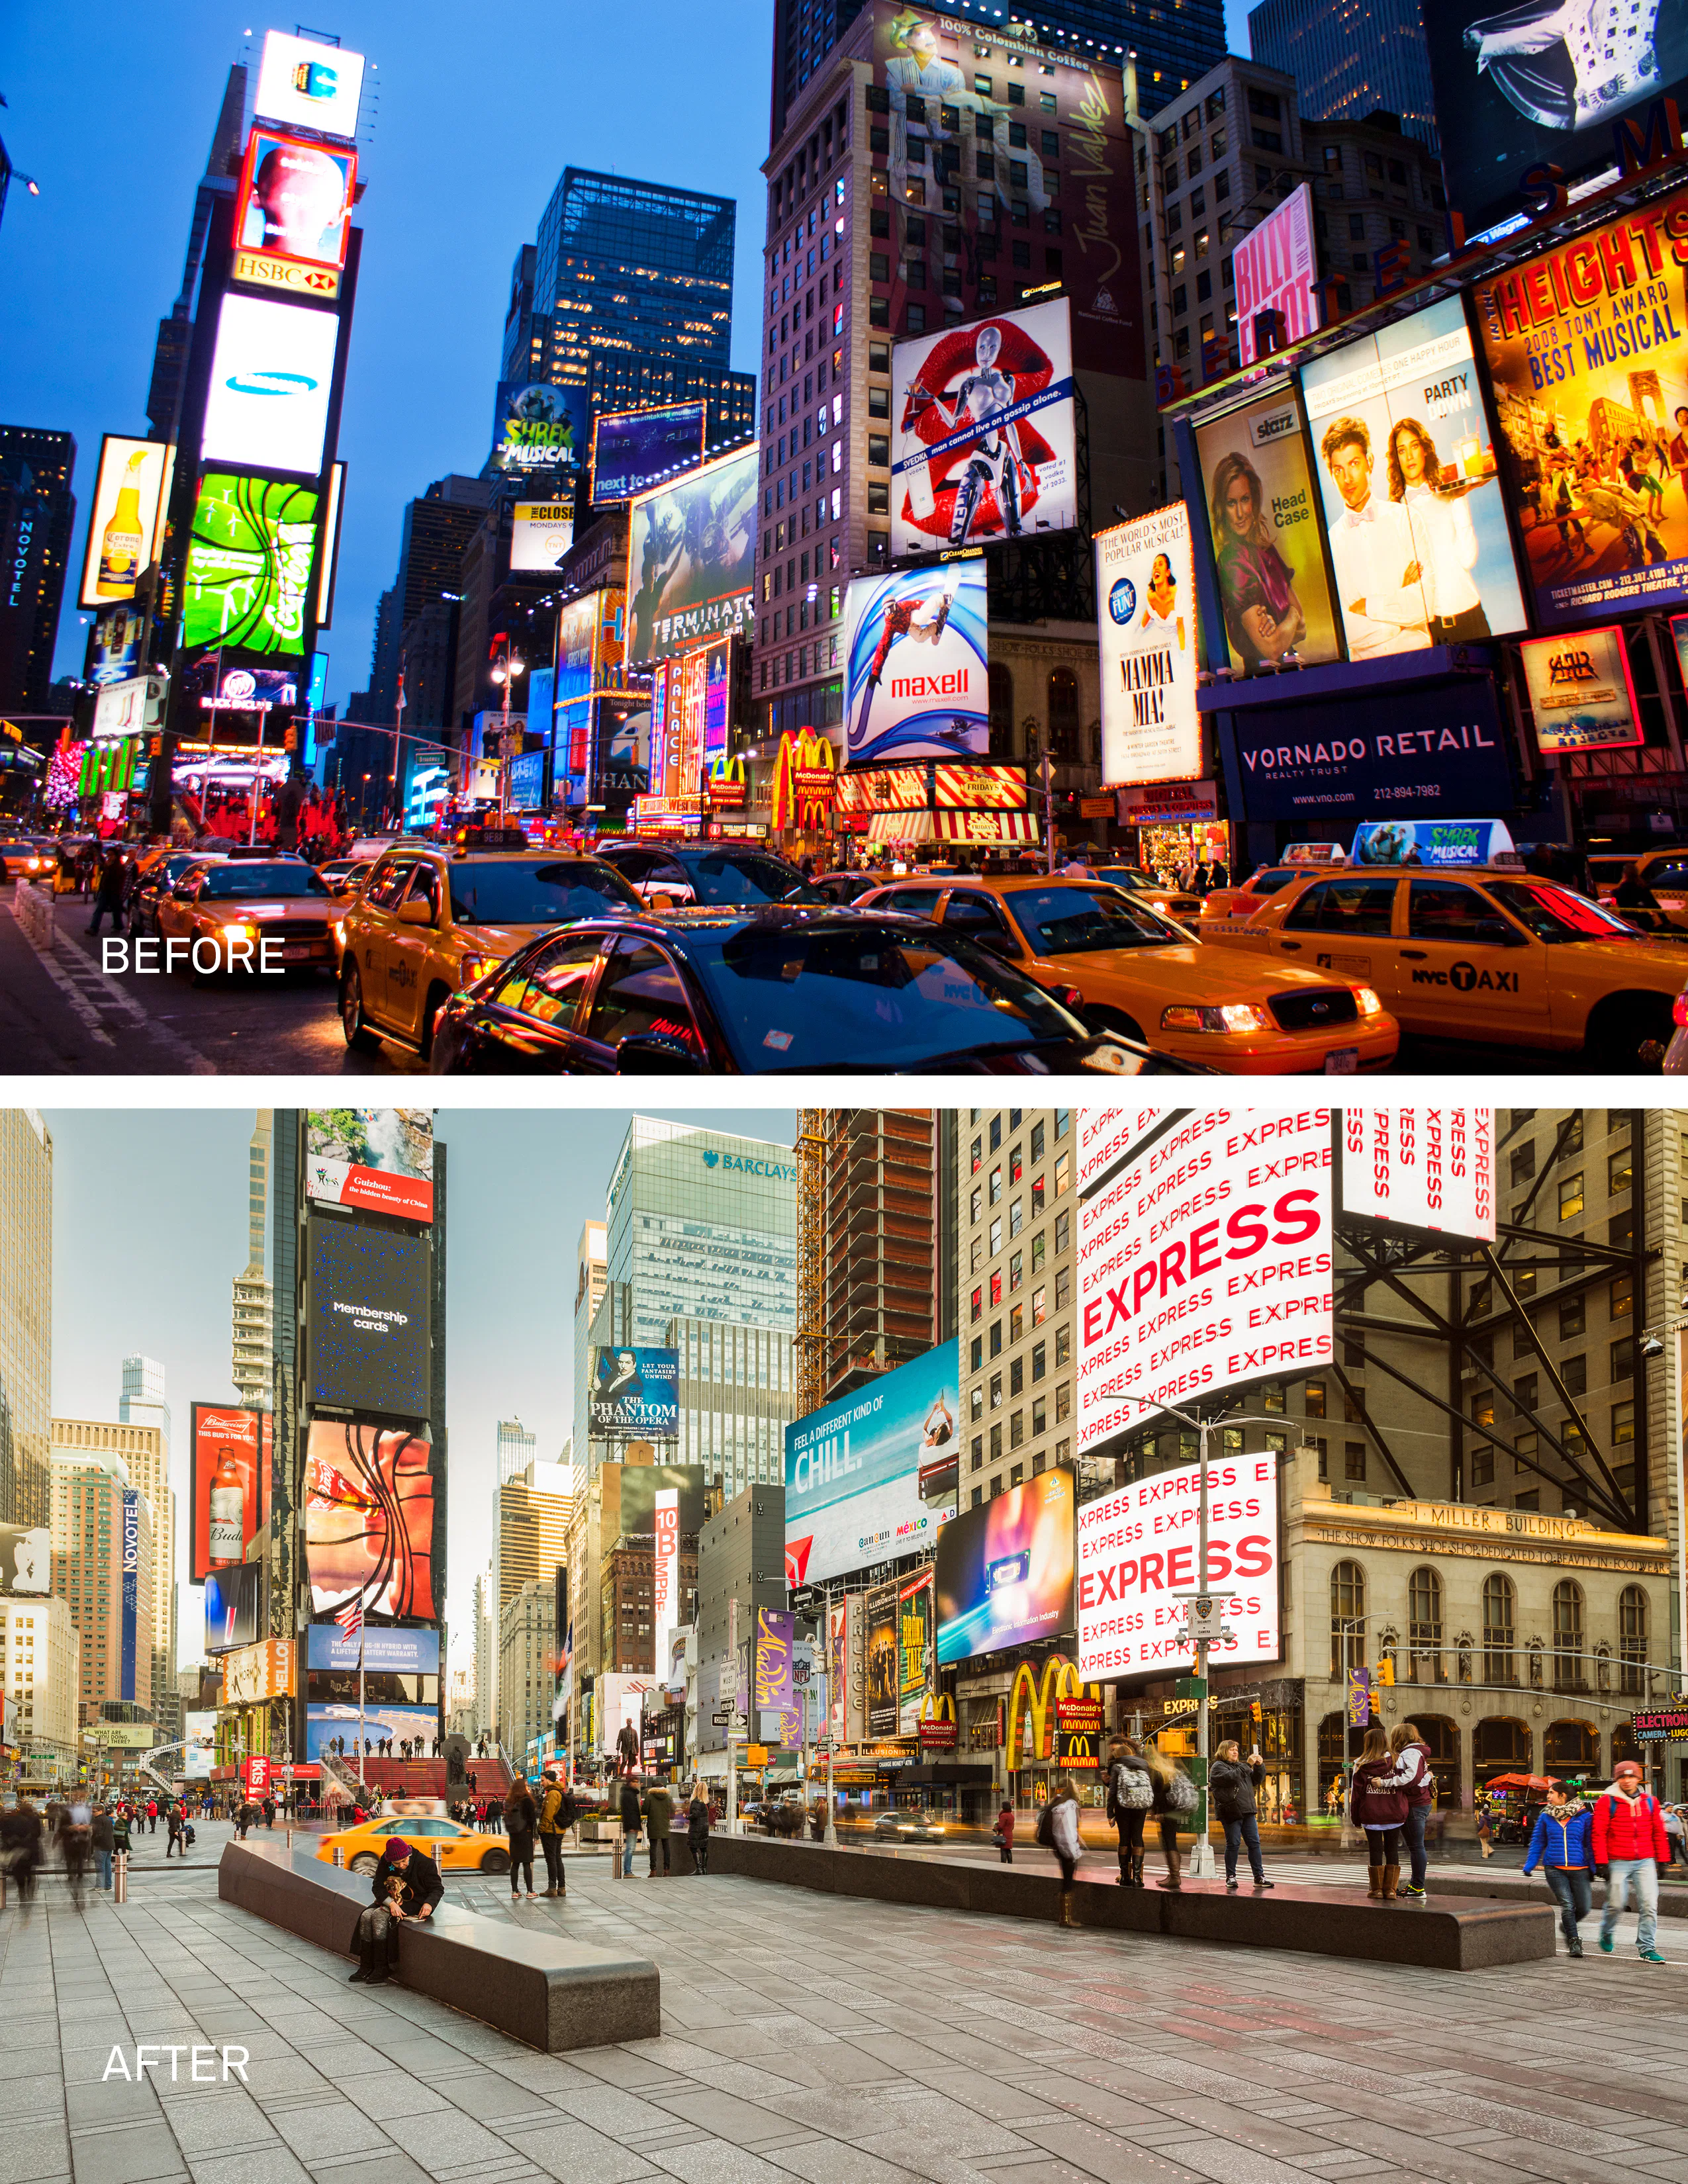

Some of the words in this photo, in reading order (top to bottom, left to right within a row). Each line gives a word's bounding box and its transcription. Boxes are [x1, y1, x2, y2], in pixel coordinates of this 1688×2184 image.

[940, 18, 971, 36] 100%
[975, 28, 1044, 58] Colombian
[238, 258, 301, 284] HSBC
[1235, 205, 1293, 320] BILLY
[1496, 203, 1688, 341] HEIGHTS
[1524, 326, 1558, 355] 2008
[1565, 308, 1601, 338] TONY
[1614, 281, 1669, 320] AWARD
[1438, 337, 1460, 353] HOUR
[1529, 342, 1575, 391] BEST
[1583, 304, 1681, 371] MUSICAL
[1424, 373, 1469, 404] PARTY
[630, 412, 665, 423] breathtaking
[1428, 390, 1472, 421] DOWN
[503, 419, 575, 447] SHREK
[931, 443, 947, 454] man
[949, 429, 974, 447] cannot
[976, 422, 990, 435] live
[992, 416, 1002, 427] on
[1004, 404, 1031, 422] gossip
[1033, 390, 1062, 406] alone.
[1258, 410, 1294, 438] starz
[504, 444, 575, 462] MUSICAL
[903, 453, 928, 469] SVEDKA
[909, 465, 926, 476] VODKA
[1038, 465, 1057, 473] voted
[1044, 469, 1064, 480] vodka
[596, 475, 626, 490] next
[1272, 490, 1306, 513] Head
[1121, 522, 1157, 544] WORLD'S
[1160, 510, 1184, 529] MOST
[1274, 508, 1309, 529] Case
[107, 532, 140, 543] Corona
[9, 522, 33, 606] NOVOTEL
[1105, 541, 1141, 563] POPULAR
[1551, 579, 1613, 600] TICKETMASTER.COM
[1571, 594, 1602, 606] RICHARD
[1604, 586, 1640, 600] RODGERS
[891, 668, 968, 698] maxell
[1120, 649, 1174, 692] MAMMA
[610, 699, 633, 707] Tonight
[912, 695, 968, 704] www.maxell.com
[1133, 688, 1165, 727] MIA!
[669, 667, 681, 766] PALACE
[1243, 738, 1366, 772] VORNADO
[1376, 725, 1495, 756] RETAIL
[1266, 769, 1305, 780] REALTY
[1311, 766, 1348, 776] TRUST
[1293, 791, 1355, 805] www.vno.com
[1374, 784, 1440, 799] 212-894-7982
[1430, 827, 1480, 846] SHREK
[1430, 845, 1479, 859] MUSICAL
[1413, 969, 1448, 985] NYC
[723, 1154, 796, 1182] BARCLAYS
[353, 1177, 391, 1192] Guizhou:
[1138, 1151, 1213, 1218] EXPRESS
[359, 1188, 381, 1199] hidden
[382, 1193, 402, 1204] beauty
[410, 1199, 428, 1209] China
[1083, 1169, 1142, 1230] EXPRESS
[1150, 1179, 1232, 1244] EXPRESS
[1084, 1189, 1321, 1348] EXPRESS
[334, 1302, 408, 1325] Membership
[353, 1319, 389, 1333] cards
[1139, 1288, 1213, 1343] EXPRESS
[1151, 1318, 1233, 1371] EXPRESS
[590, 1402, 677, 1418] PHANTOM
[794, 1432, 808, 1451] FEEL
[816, 1411, 852, 1441] DIFFERENT
[854, 1400, 872, 1422] KIND
[873, 1394, 884, 1414] OF
[206, 1417, 248, 1430] Budweiser
[795, 1430, 863, 1494] CHILL.
[657, 1510, 676, 1529] 10
[1431, 1508, 1491, 1528] MILLER
[1506, 1516, 1575, 1537] BUILDING
[123, 1498, 138, 1572] NOVOTEL
[1082, 1523, 1143, 1559] EXPRESS
[1321, 1529, 1341, 1543] THE
[1345, 1531, 1376, 1547] SHOW
[1382, 1535, 1415, 1550] FOLKS
[1420, 1539, 1448, 1553] SHOE
[1451, 1541, 1478, 1556] SHOP
[1481, 1545, 1536, 1562] DEDICATED
[1538, 1550, 1554, 1563] TO
[1597, 1556, 1608, 1568] IN
[1613, 1557, 1666, 1574] FOOTWEAR
[1080, 1535, 1273, 1611] EXPRESS
[869, 1593, 897, 1610] ILLUSIONISTS
[903, 1615, 924, 1647] BRONX
[992, 1623, 1012, 1635] Electronic
[1013, 1615, 1038, 1630] Information
[1040, 1610, 1058, 1623] Industry
[1083, 1613, 1144, 1643] EXPRESS
[275, 1642, 290, 1694] HELLO!
[853, 1604, 863, 1710] PALACE
[907, 1647, 923, 1681] TALE
[239, 1667, 261, 1682] MORMON
[794, 1670, 809, 1684] NFL
[1059, 1704, 1102, 1712] McDonald's
[1638, 1730, 1667, 1739] CAMERA
[252, 1759, 267, 1785] tkts
